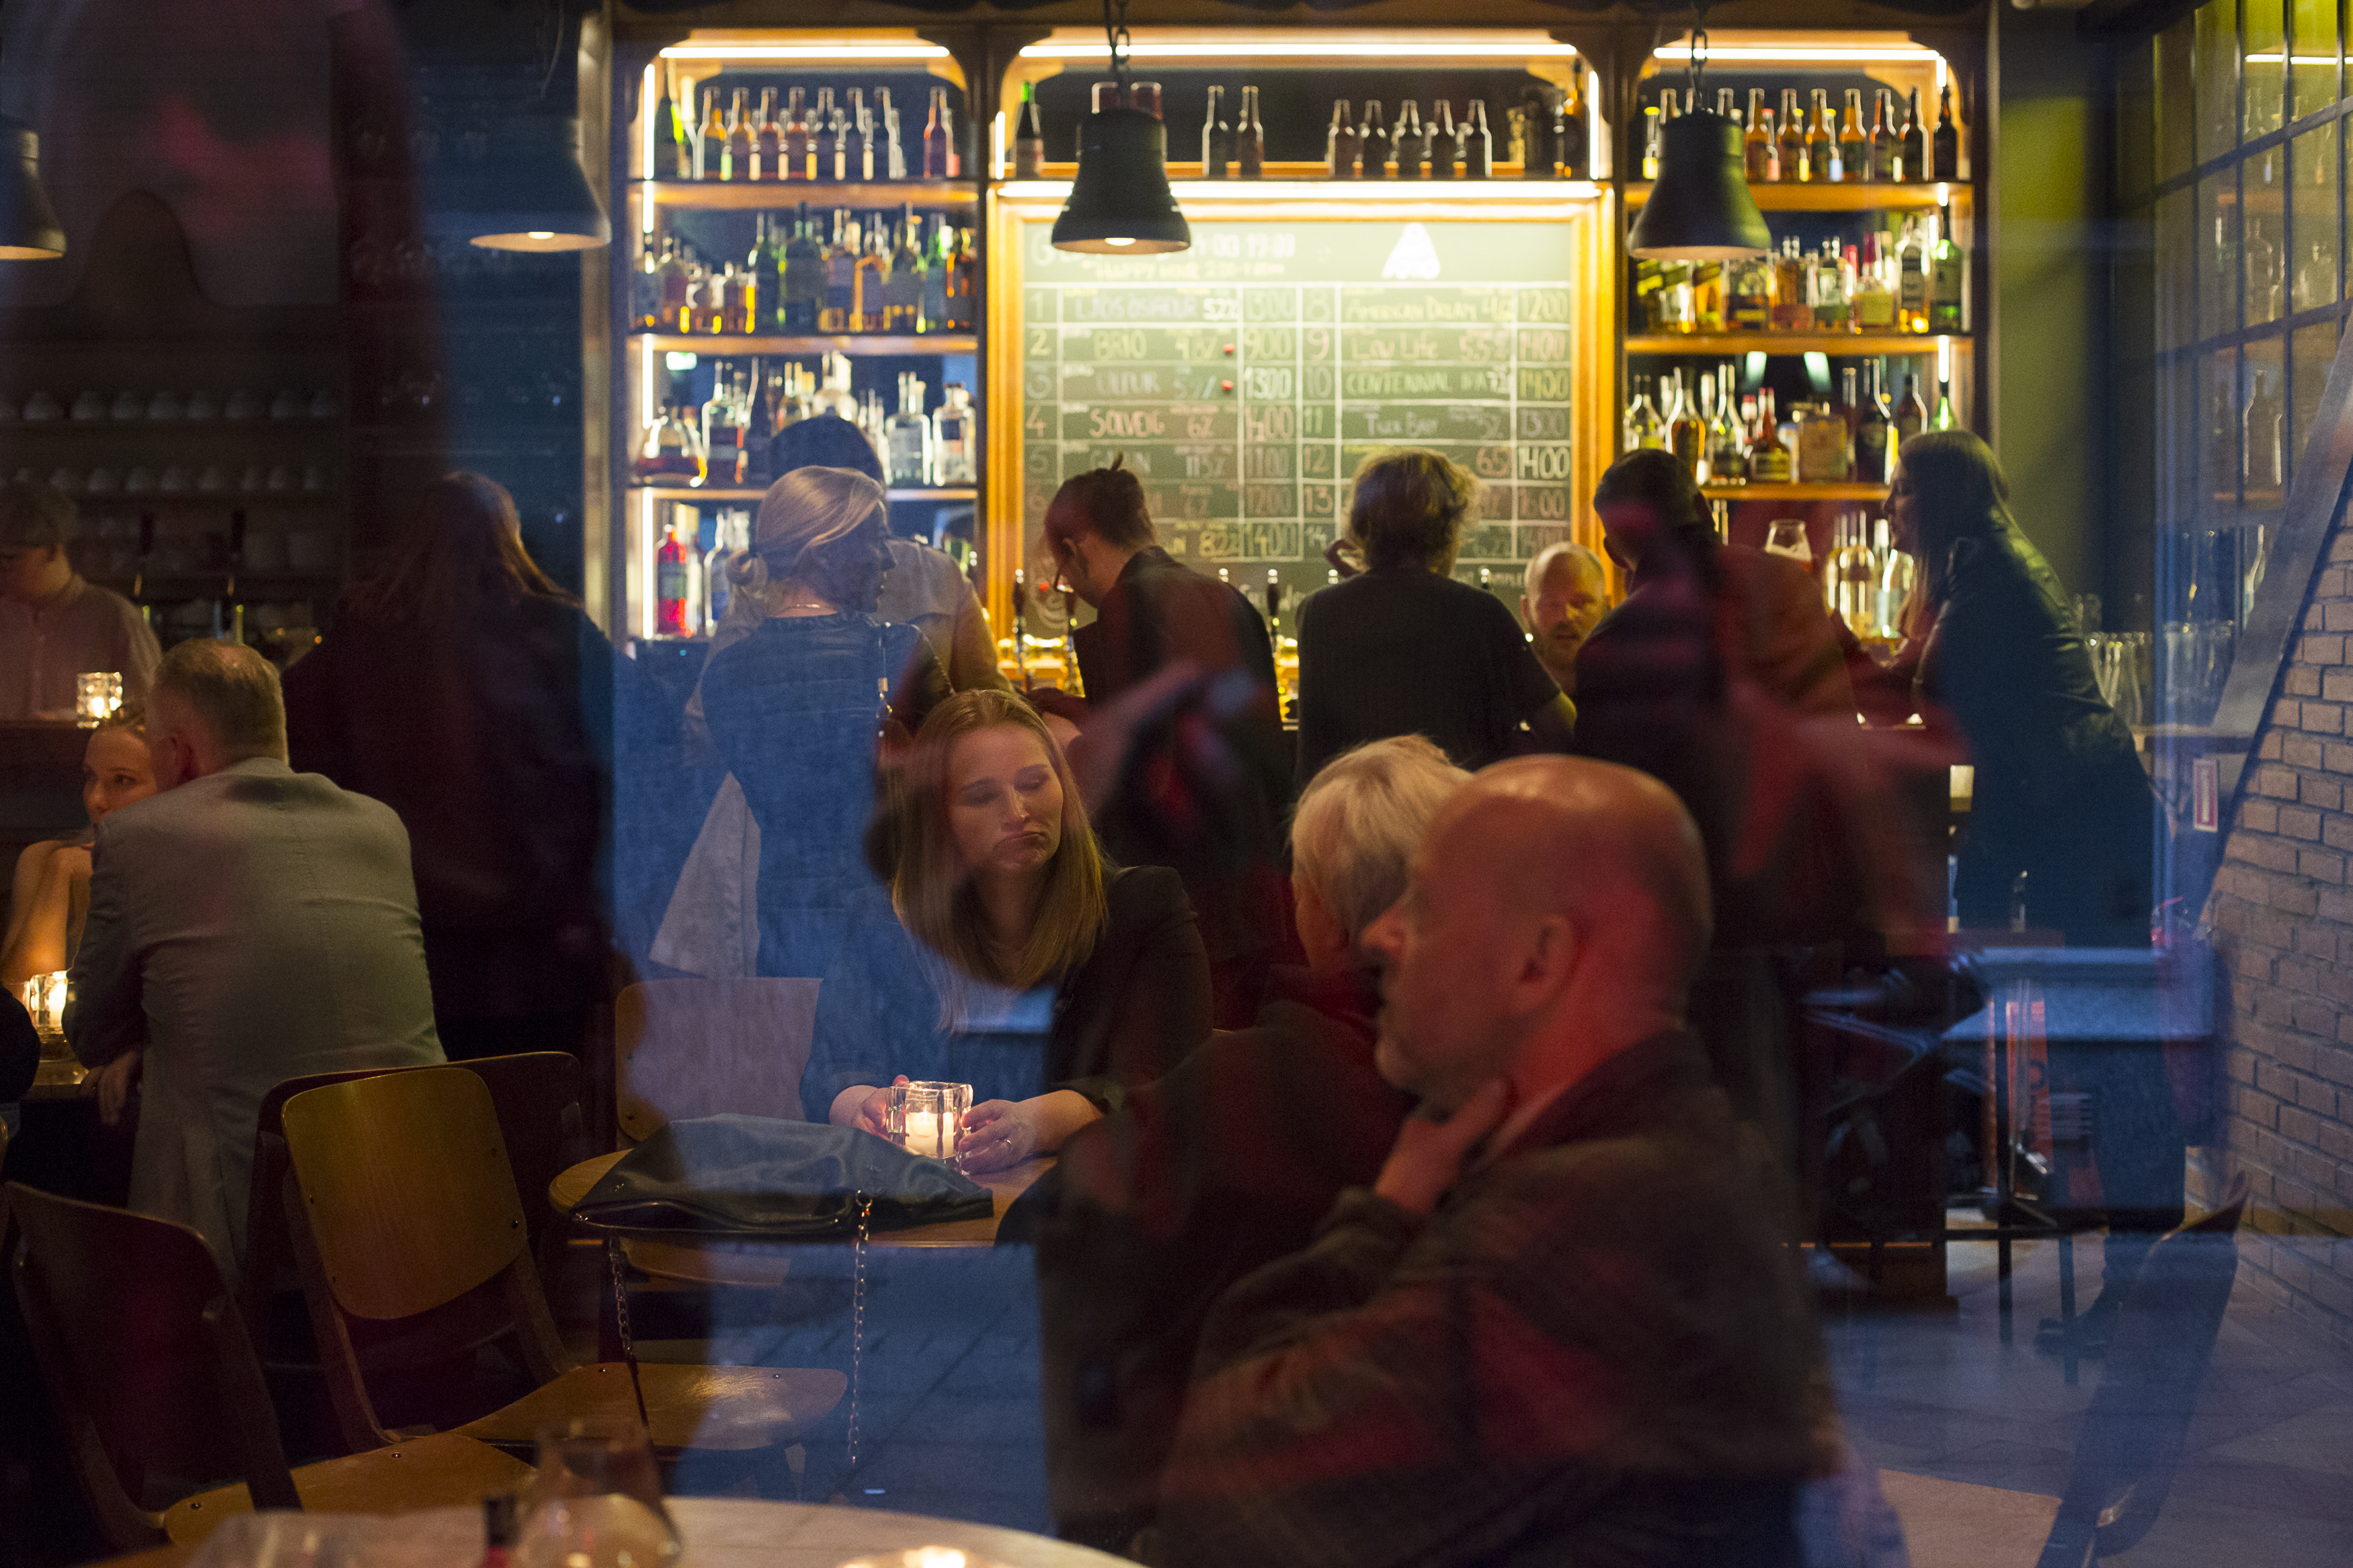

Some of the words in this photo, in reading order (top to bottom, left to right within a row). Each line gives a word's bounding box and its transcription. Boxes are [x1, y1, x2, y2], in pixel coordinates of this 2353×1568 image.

[1519, 290, 1568, 321] 1200
[1029, 329, 1051, 356] 2
[1244, 328, 1292, 359] 900
[1307, 327, 1329, 362] 9
[1306, 367, 1332, 398] 10
[1025, 405, 1047, 438] 4
[1303, 407, 1324, 435] 11
[1028, 446, 1049, 473] 5
[1303, 445, 1328, 473] 12
[1519, 446, 1570, 479] 1400
[1304, 485, 1334, 513] 13
